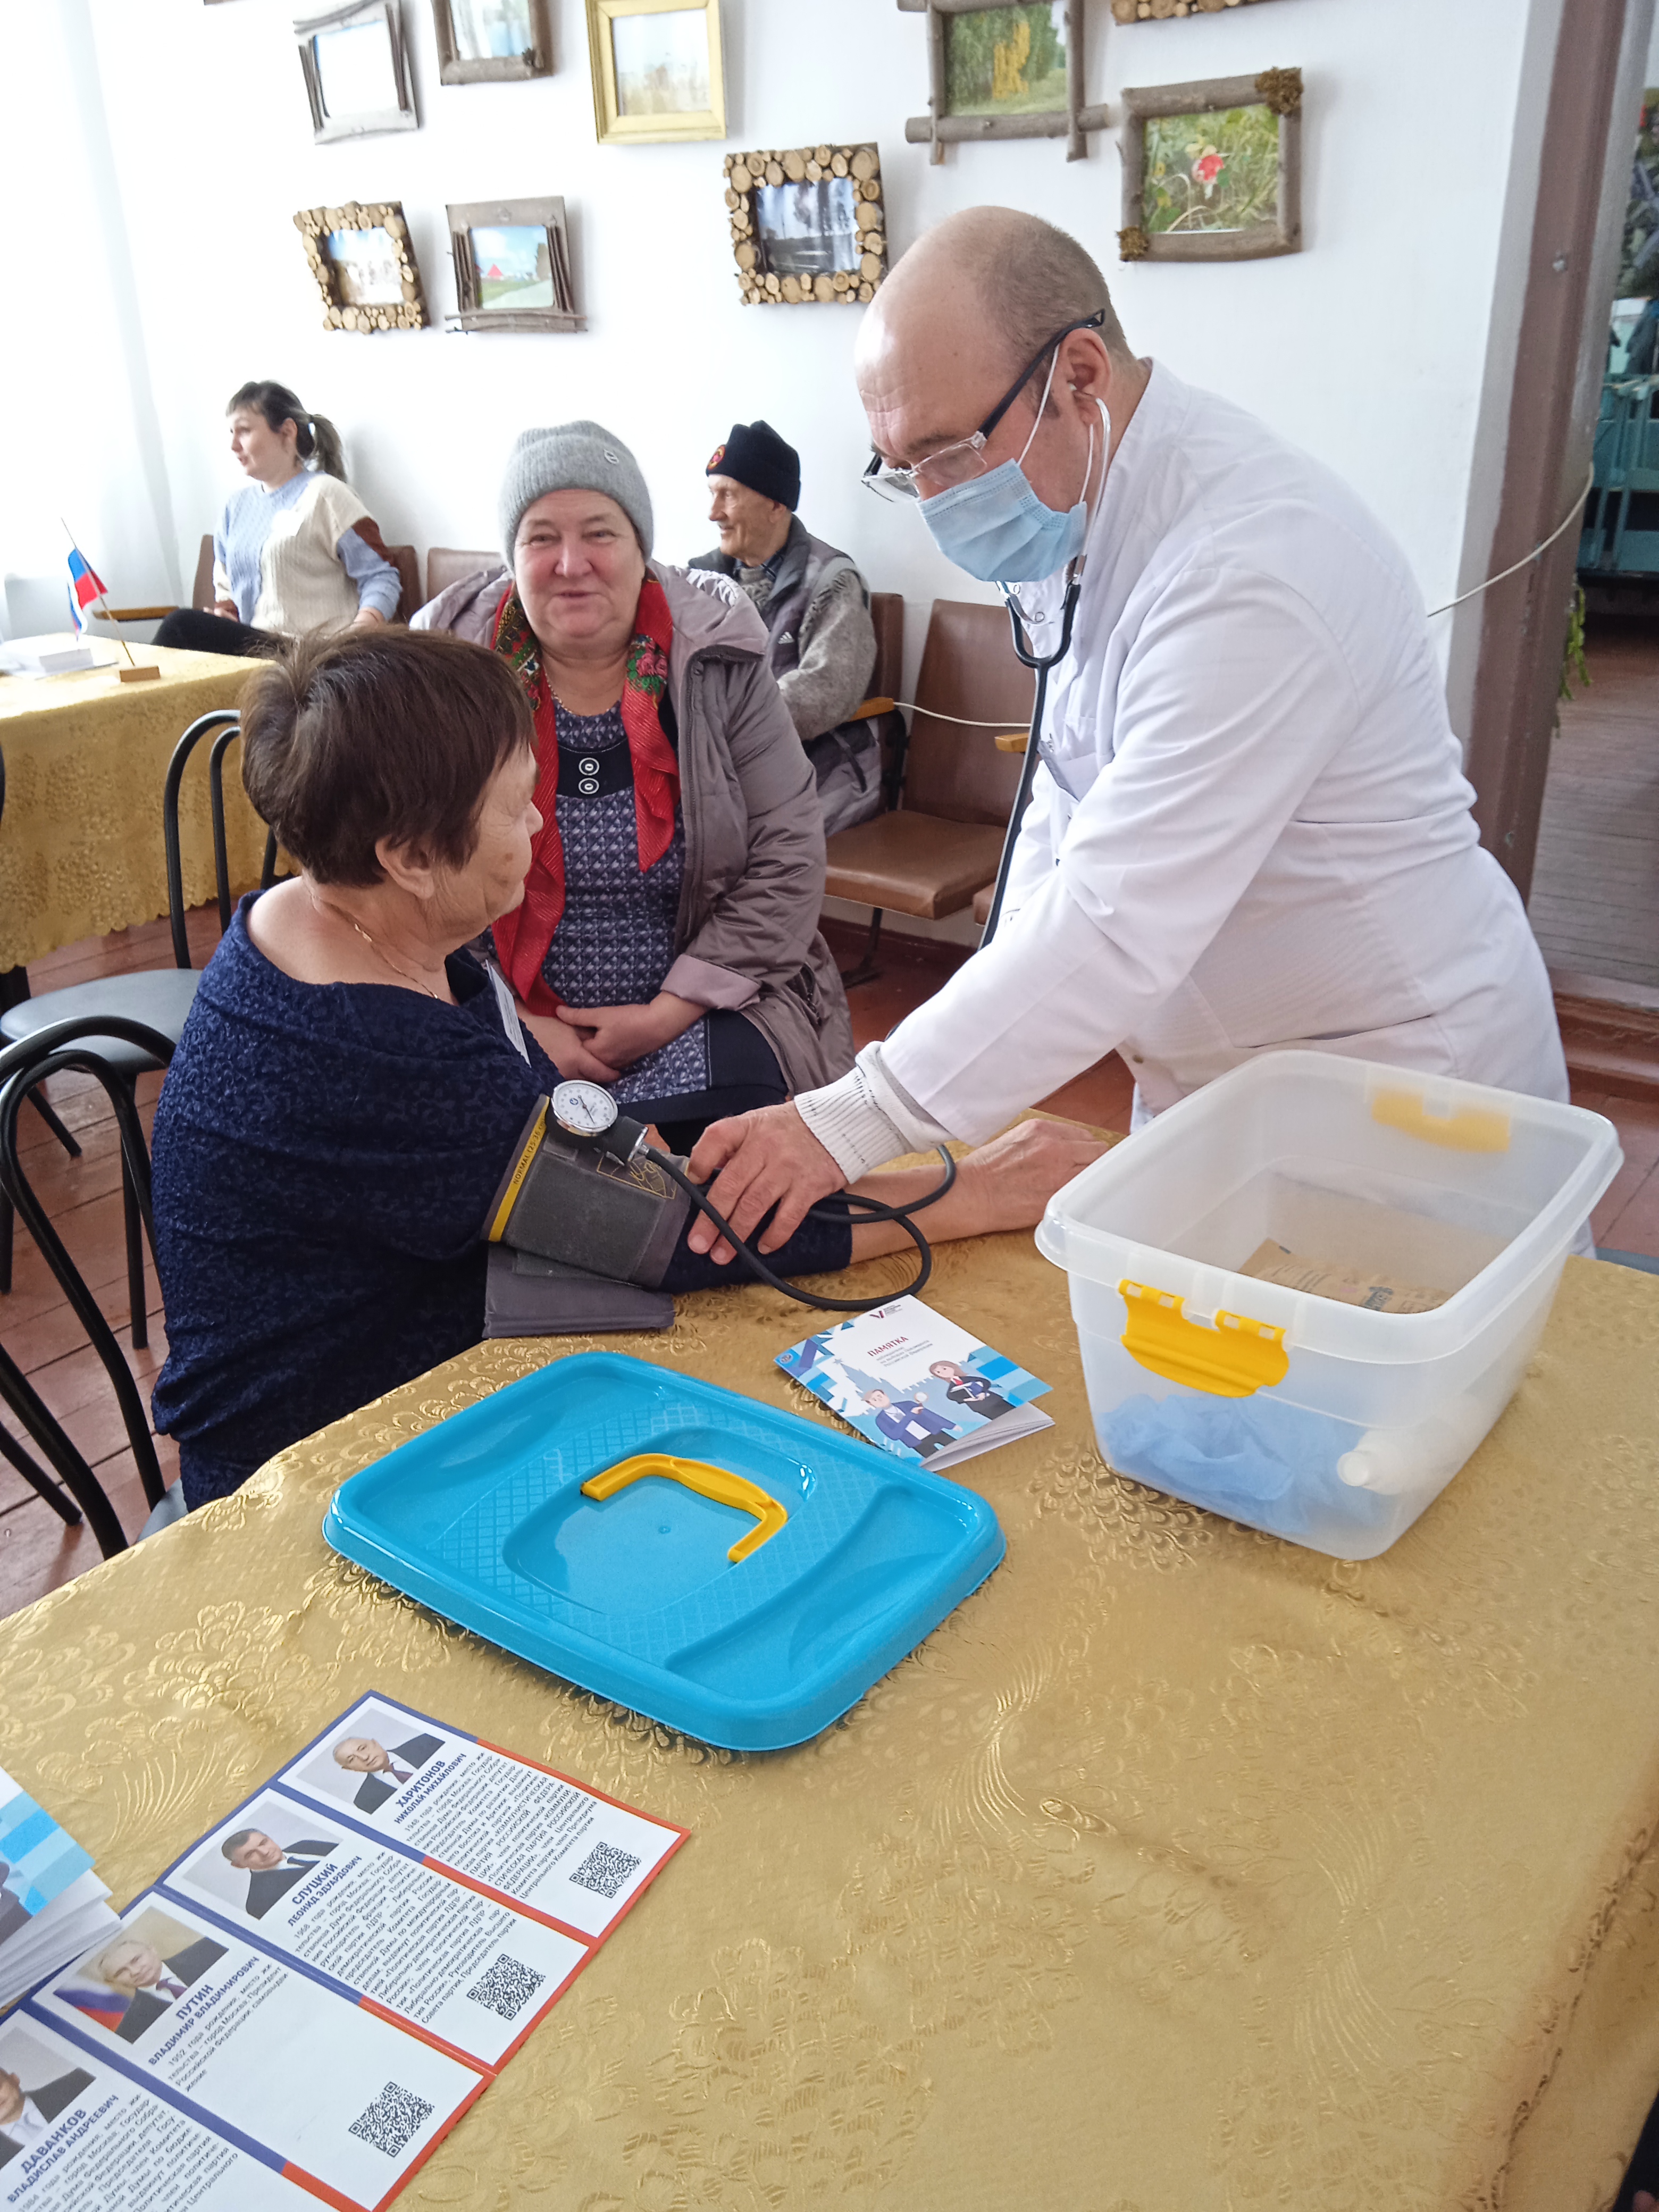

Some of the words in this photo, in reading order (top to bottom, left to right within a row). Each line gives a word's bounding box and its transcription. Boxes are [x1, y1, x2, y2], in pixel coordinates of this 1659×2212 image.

[867, 1336, 909, 1356] ПАМЯТКА
[393, 1794, 426, 1824] НИКОЛАЙ
[423, 1753, 466, 1795] МИХАЙЛОВИЧ
[395, 1761, 445, 1807] ХАРИТОНОВ
[436, 1808, 453, 1824] Дума
[451, 1774, 485, 1809] Федерального
[459, 1761, 476, 1778] место
[422, 1839, 433, 1850] ния
[430, 1810, 462, 1841] Российской
[430, 1820, 466, 1854] председатель
[467, 1790, 493, 1815] Комитета
[438, 1833, 463, 1858] ственной
[461, 1817, 479, 1834] Думы
[485, 1783, 510, 1809] развитию
[445, 1849, 459, 1863] него
[457, 1827, 481, 1849] Востока
[508, 1770, 532, 1796] выдвинут
[454, 1830, 490, 1866] политической
[491, 1805, 512, 1828] партией
[469, 1850, 493, 1875] ПАРТИЯ
[495, 1809, 531, 1847] РОССИЙСКОЙ
[494, 1853, 526, 1887] СТИЧЕСКАЯ
[524, 1829, 548, 1853] ПАРТИЯ
[547, 1791, 581, 1828] РОССИЙСКОЙ
[497, 1844, 511, 1858] член
[512, 1806, 546, 1842] политической
[546, 1784, 565, 1804] партии
[510, 1867, 537, 1895] Комитета
[555, 1833, 569, 1846] член
[566, 1800, 597, 1832] Президиума
[524, 1822, 543, 1841] партия
[540, 1836, 554, 1849] член
[554, 1796, 589, 1833] Центрального
[291, 1863, 338, 1905] СЛУЦКИЙ
[462, 1857, 476, 1871] ская
[475, 1837, 495, 1857] партия
[519, 1861, 556, 1899] Центрального
[552, 1835, 579, 1862] Комитета
[576, 1816, 594, 1836] партии
[287, 1896, 320, 1926] ЛЕОНИД
[316, 1856, 362, 1897] ЭДУАРДОВИЧ
[329, 1899, 348, 1916] город
[329, 1912, 346, 1930] Дума
[311, 1949, 324, 1963] ния
[322, 1914, 356, 1949] Российской
[320, 1925, 359, 1967] руководитель
[362, 1896, 387, 1921] фракции
[325, 1954, 343, 1972] ской
[343, 1931, 365, 1953] партии
[365, 1911, 382, 1930] ЛДПР
[337, 1922, 387, 1977] демократической
[389, 1898, 410, 1919] партии
[345, 1938, 384, 1981] председатель
[387, 1905, 416, 1933] Комитета
[353, 1955, 380, 1985] ственной
[379, 1937, 398, 1956] Думы
[397, 1928, 407, 1938] по
[406, 1882, 451, 1927] международным
[370, 1978, 386, 1994] тией
[425, 1913, 446, 1934] партия
[443, 1896, 460, 1913] ЛДПР
[378, 1913, 458, 1999] Либерально-демократическая
[456, 1895, 476, 1914] партия
[382, 1937, 410, 1967] выдвинут
[409, 1898, 447, 1937] политической
[395, 1996, 408, 2009] тии
[449, 1928, 470, 1949] партия
[468, 1909, 485, 1928] ЛДПР
[413, 2006, 426, 2018] тия
[448, 1938, 487, 1978] Руководитель
[484, 1912, 510, 1937] Высшего
[414, 1957, 430, 1972] член
[432, 1914, 470, 1954] политической
[175, 1984, 213, 2020] ПУТИН
[404, 1926, 483, 2014] Либерально-демократическая
[421, 2000, 443, 2024] Совета
[460, 1938, 499, 1978] Председатель
[497, 1918, 517, 1938] партии
[148, 2017, 194, 2065] ВЛАДИМИР
[194, 1956, 259, 2018] ВЛАДИМИРОВИЧ
[174, 2046, 216, 2087] Российской
[185, 2068, 207, 2092] жение
[7, 2146, 65, 2203] ВЛАДИСЛАВ
[65, 2094, 118, 2148] АНДРЕЕВИЧ
[21, 2109, 86, 2174] ДАВАНКОВ
[149, 2119, 186, 2155] Комитета
[136, 2163, 186, 2210] Политическая
[186, 2135, 212, 2163] партия
